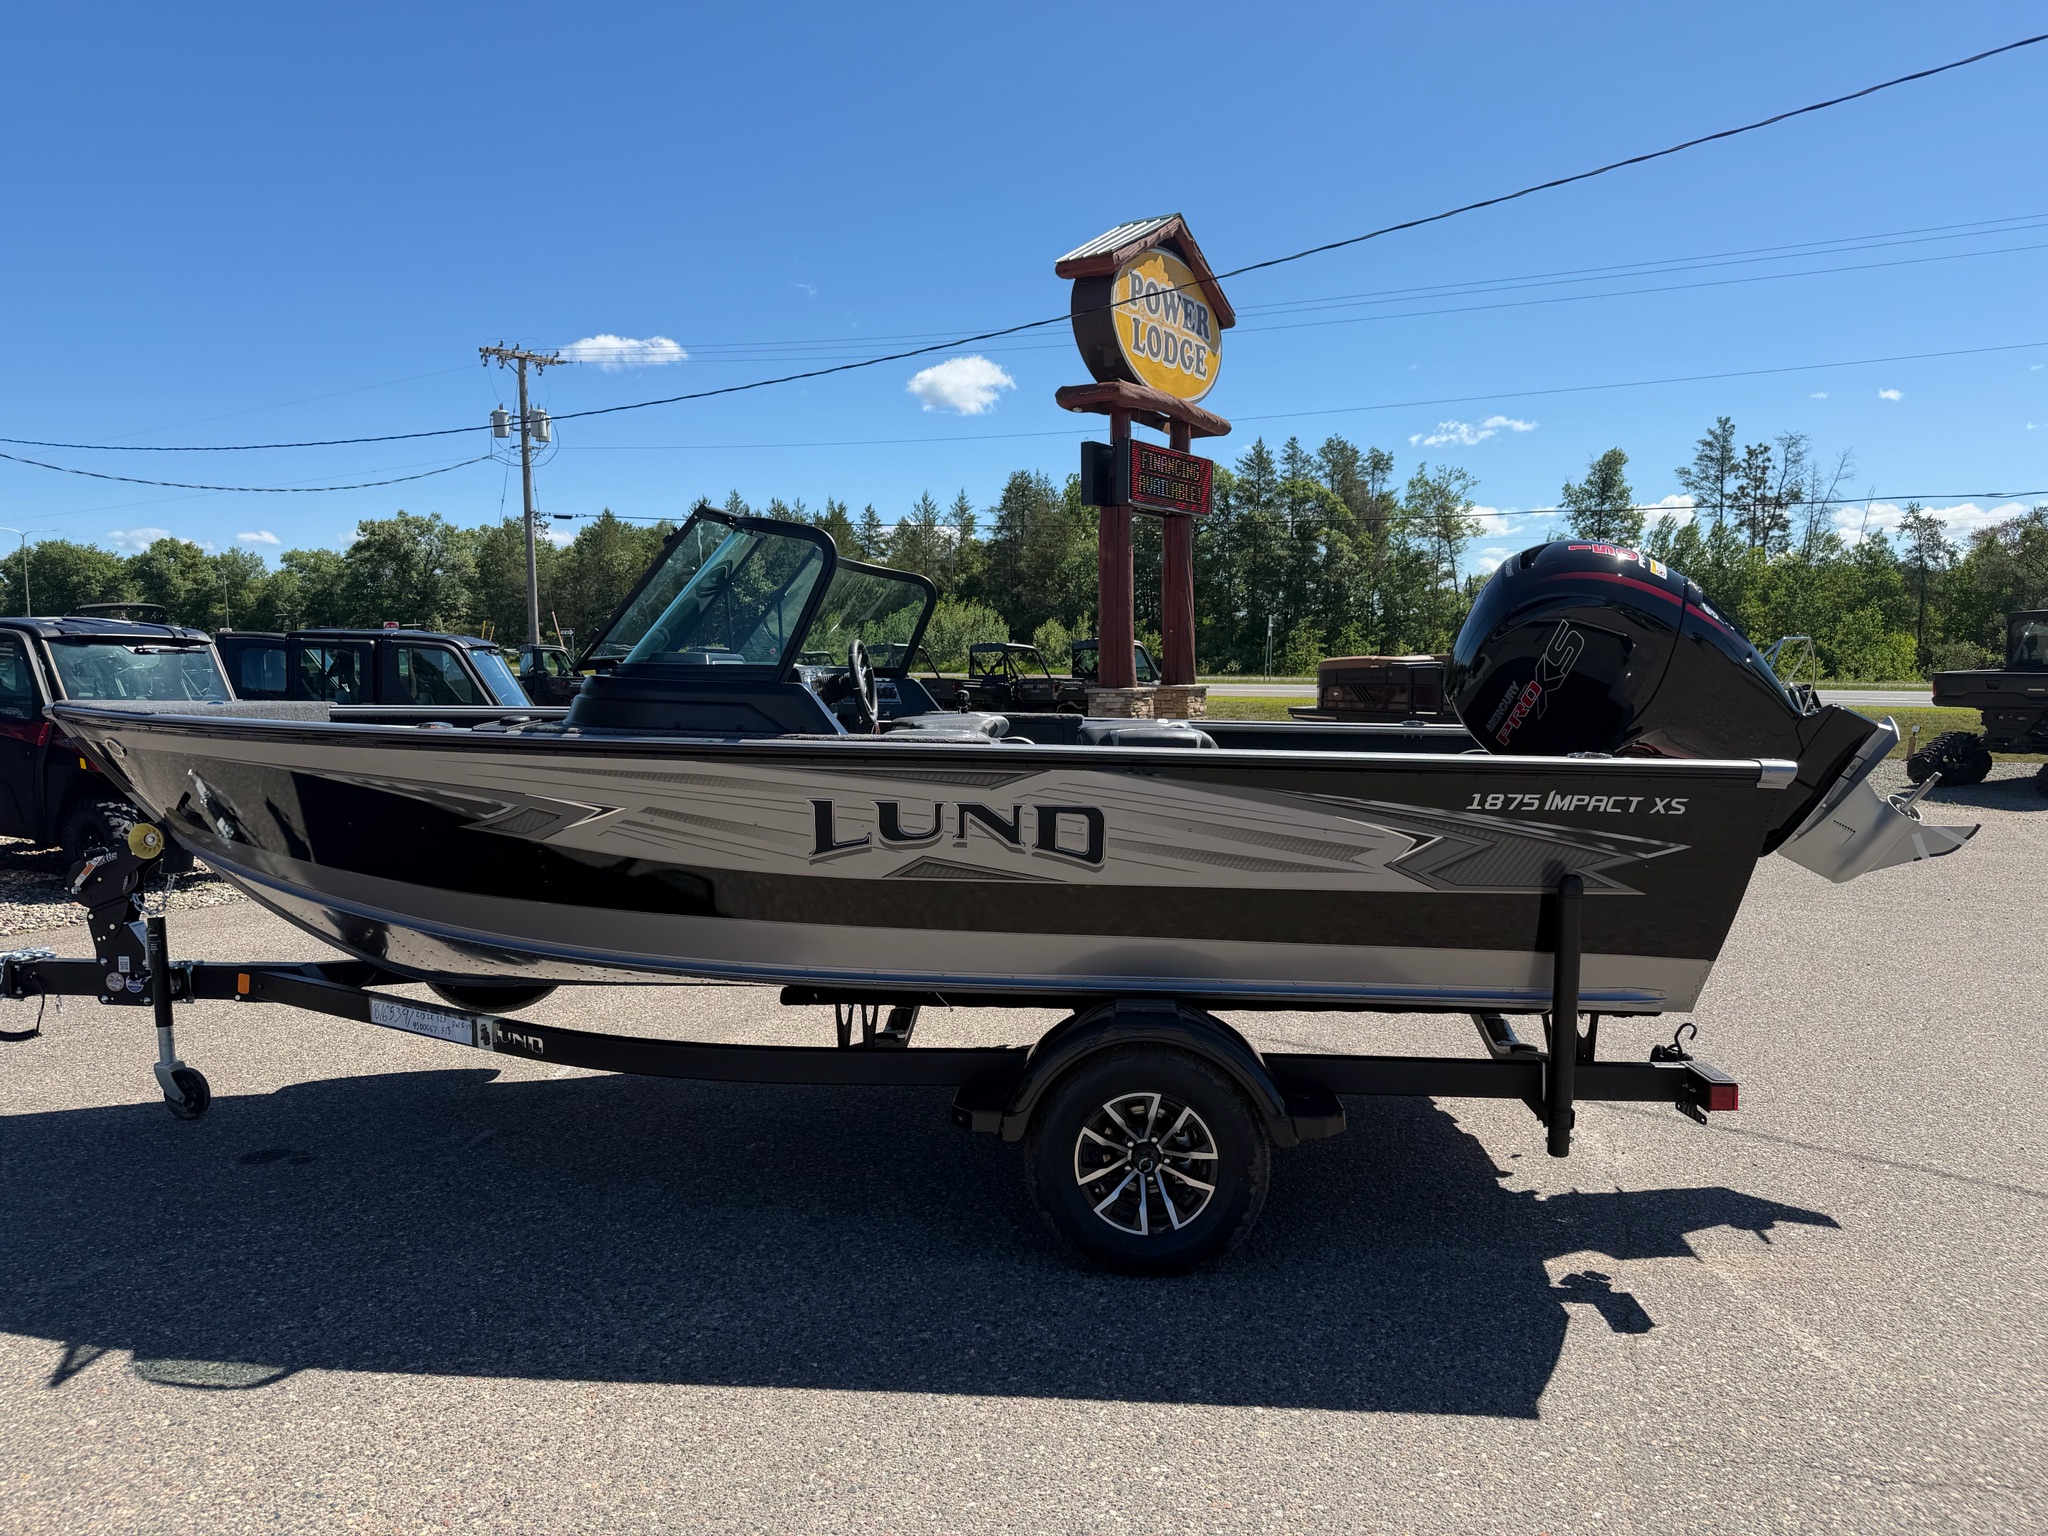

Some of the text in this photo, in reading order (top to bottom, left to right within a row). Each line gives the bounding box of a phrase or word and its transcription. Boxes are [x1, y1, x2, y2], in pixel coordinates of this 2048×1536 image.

[1129, 271, 1210, 341] POWER
[1131, 317, 1208, 379] LODGE
[1141, 451, 1200, 481] FINANCING
[1485, 680, 1520, 733] MERCURY
[1495, 680, 1543, 746] PRO
[806, 797, 1106, 869] LUND
[1466, 789, 1690, 815] 1875 IMPACT XS
